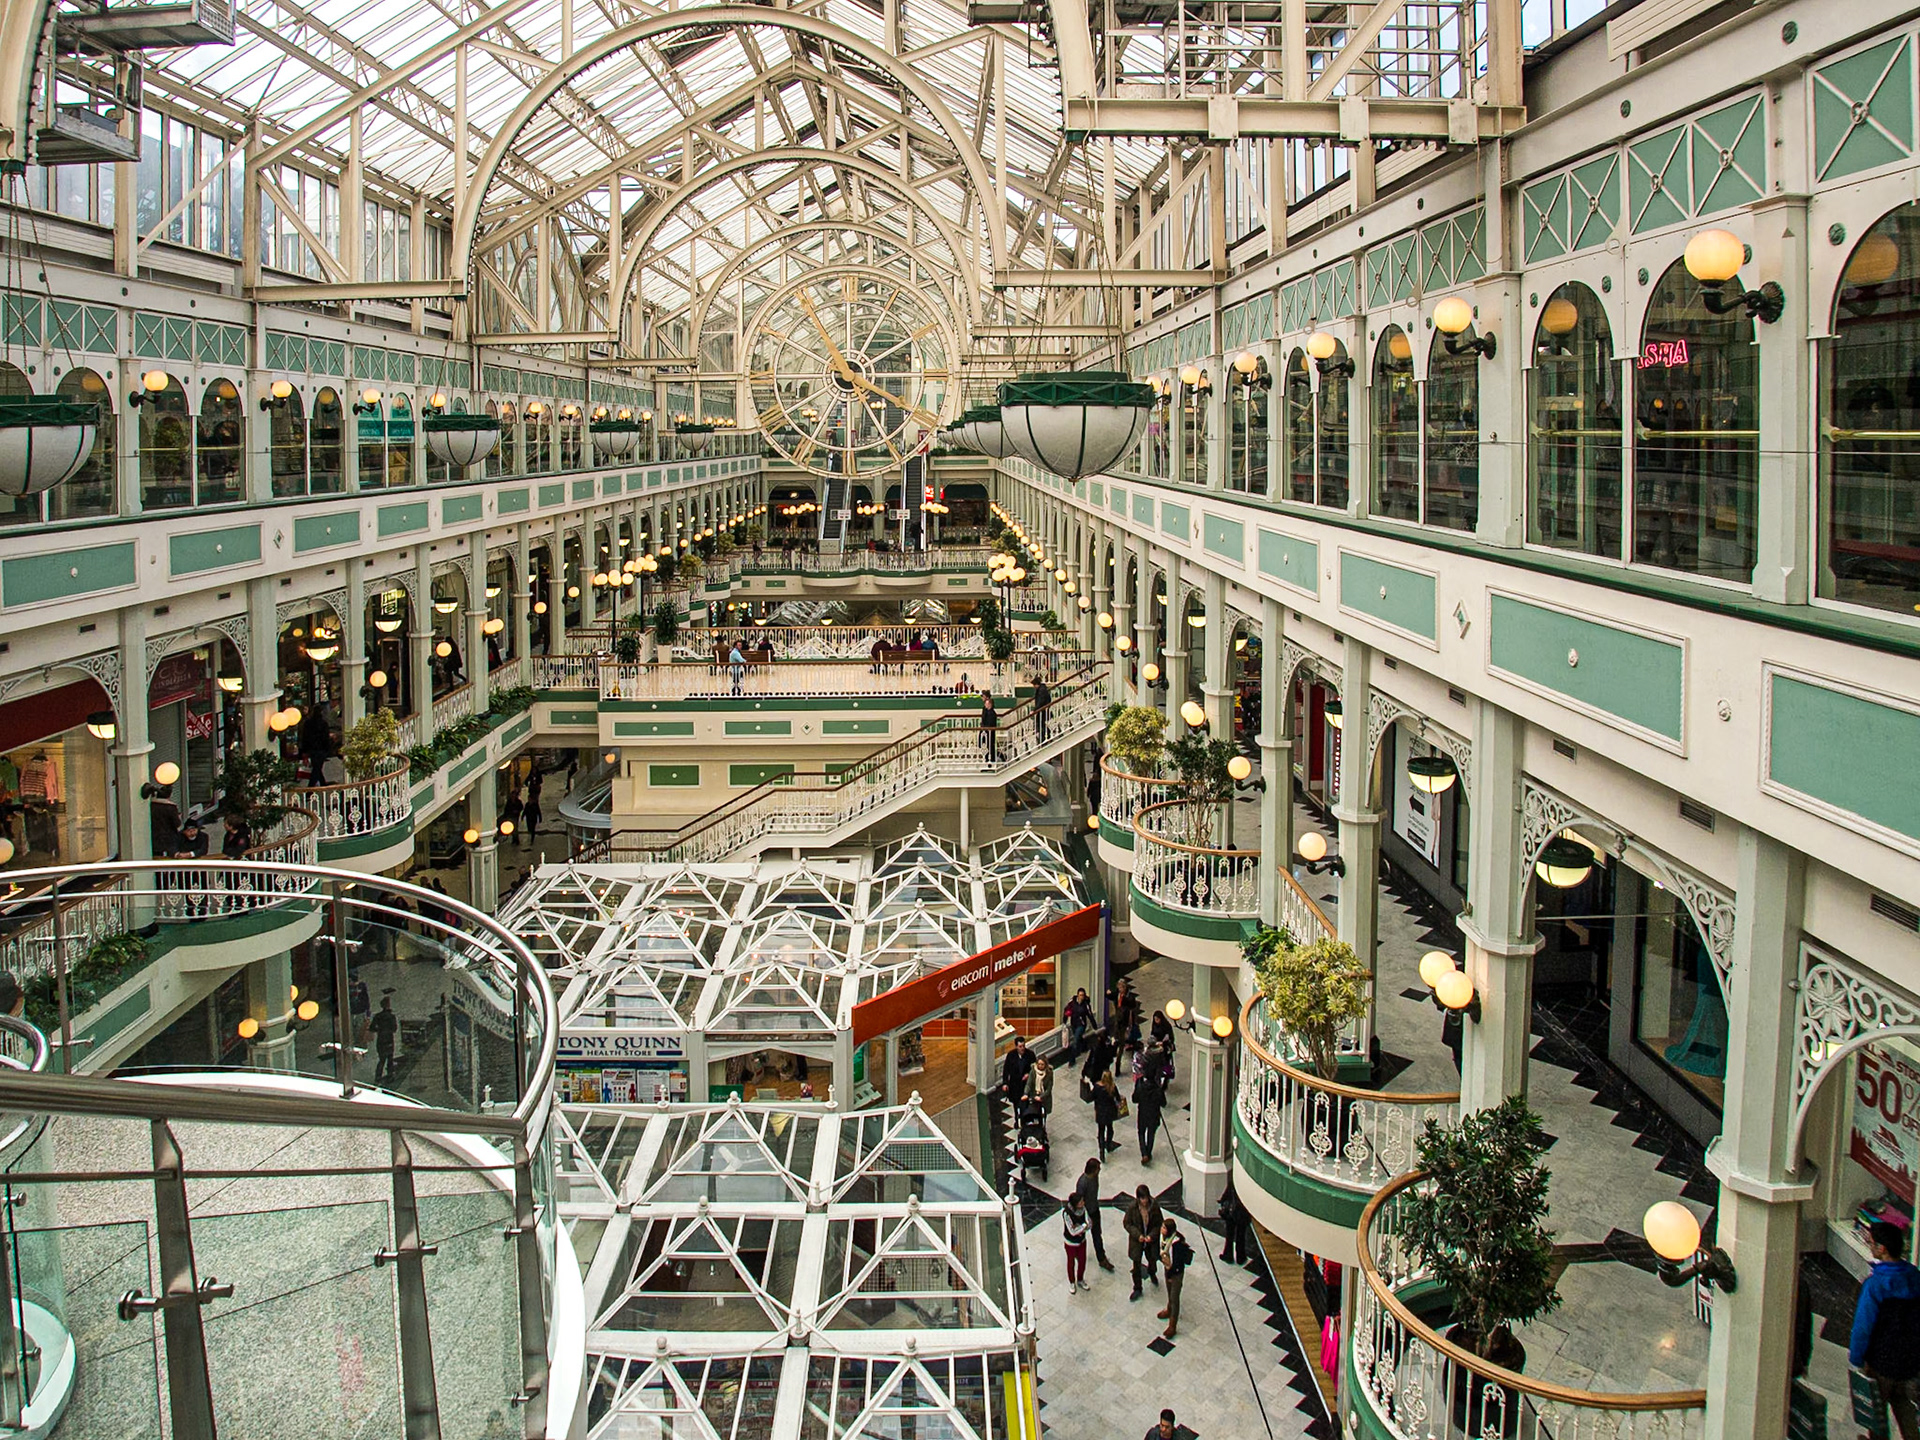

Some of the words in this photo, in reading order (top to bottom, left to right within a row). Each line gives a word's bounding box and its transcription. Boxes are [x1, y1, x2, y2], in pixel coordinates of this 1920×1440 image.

[994, 944, 1036, 973] meteor
[559, 1036, 608, 1049] TONY
[615, 1036, 681, 1050] QUINN
